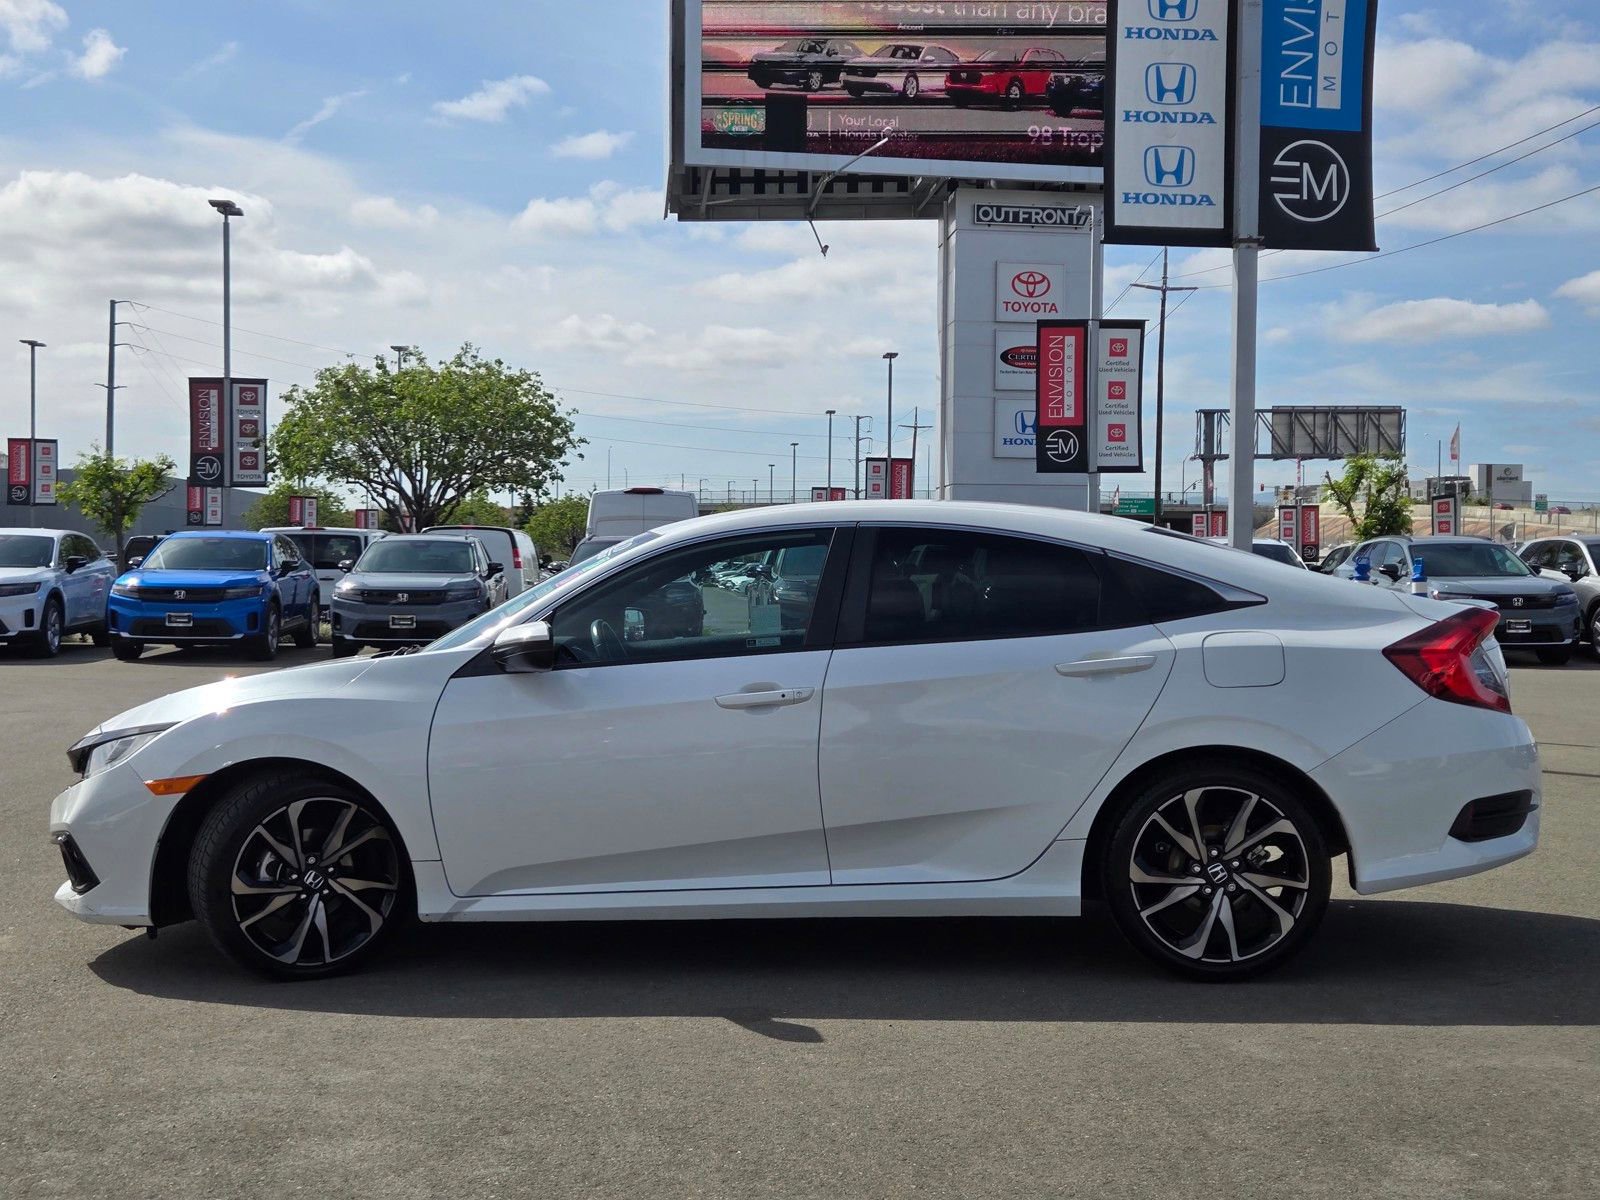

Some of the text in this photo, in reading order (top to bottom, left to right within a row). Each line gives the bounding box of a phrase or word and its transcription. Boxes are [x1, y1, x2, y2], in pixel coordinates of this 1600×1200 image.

[954, 3, 1006, 17] than
[1017, 3, 1059, 27] any
[1125, 27, 1219, 41] HONDA
[1280, 0, 1316, 107] ENVI
[722, 112, 757, 129] SPRING
[839, 114, 899, 127] Your Local
[1122, 110, 1217, 124] HONDA
[1027, 125, 1104, 153] 98 Trop
[1122, 192, 1216, 206] HONDA
[978, 206, 1081, 225] OUTFRONT
[1003, 300, 1059, 314] TOYOTA
[1048, 335, 1063, 418] ENVISION
[199, 389, 210, 448] ENVISION
[1003, 437, 1036, 446] HON
